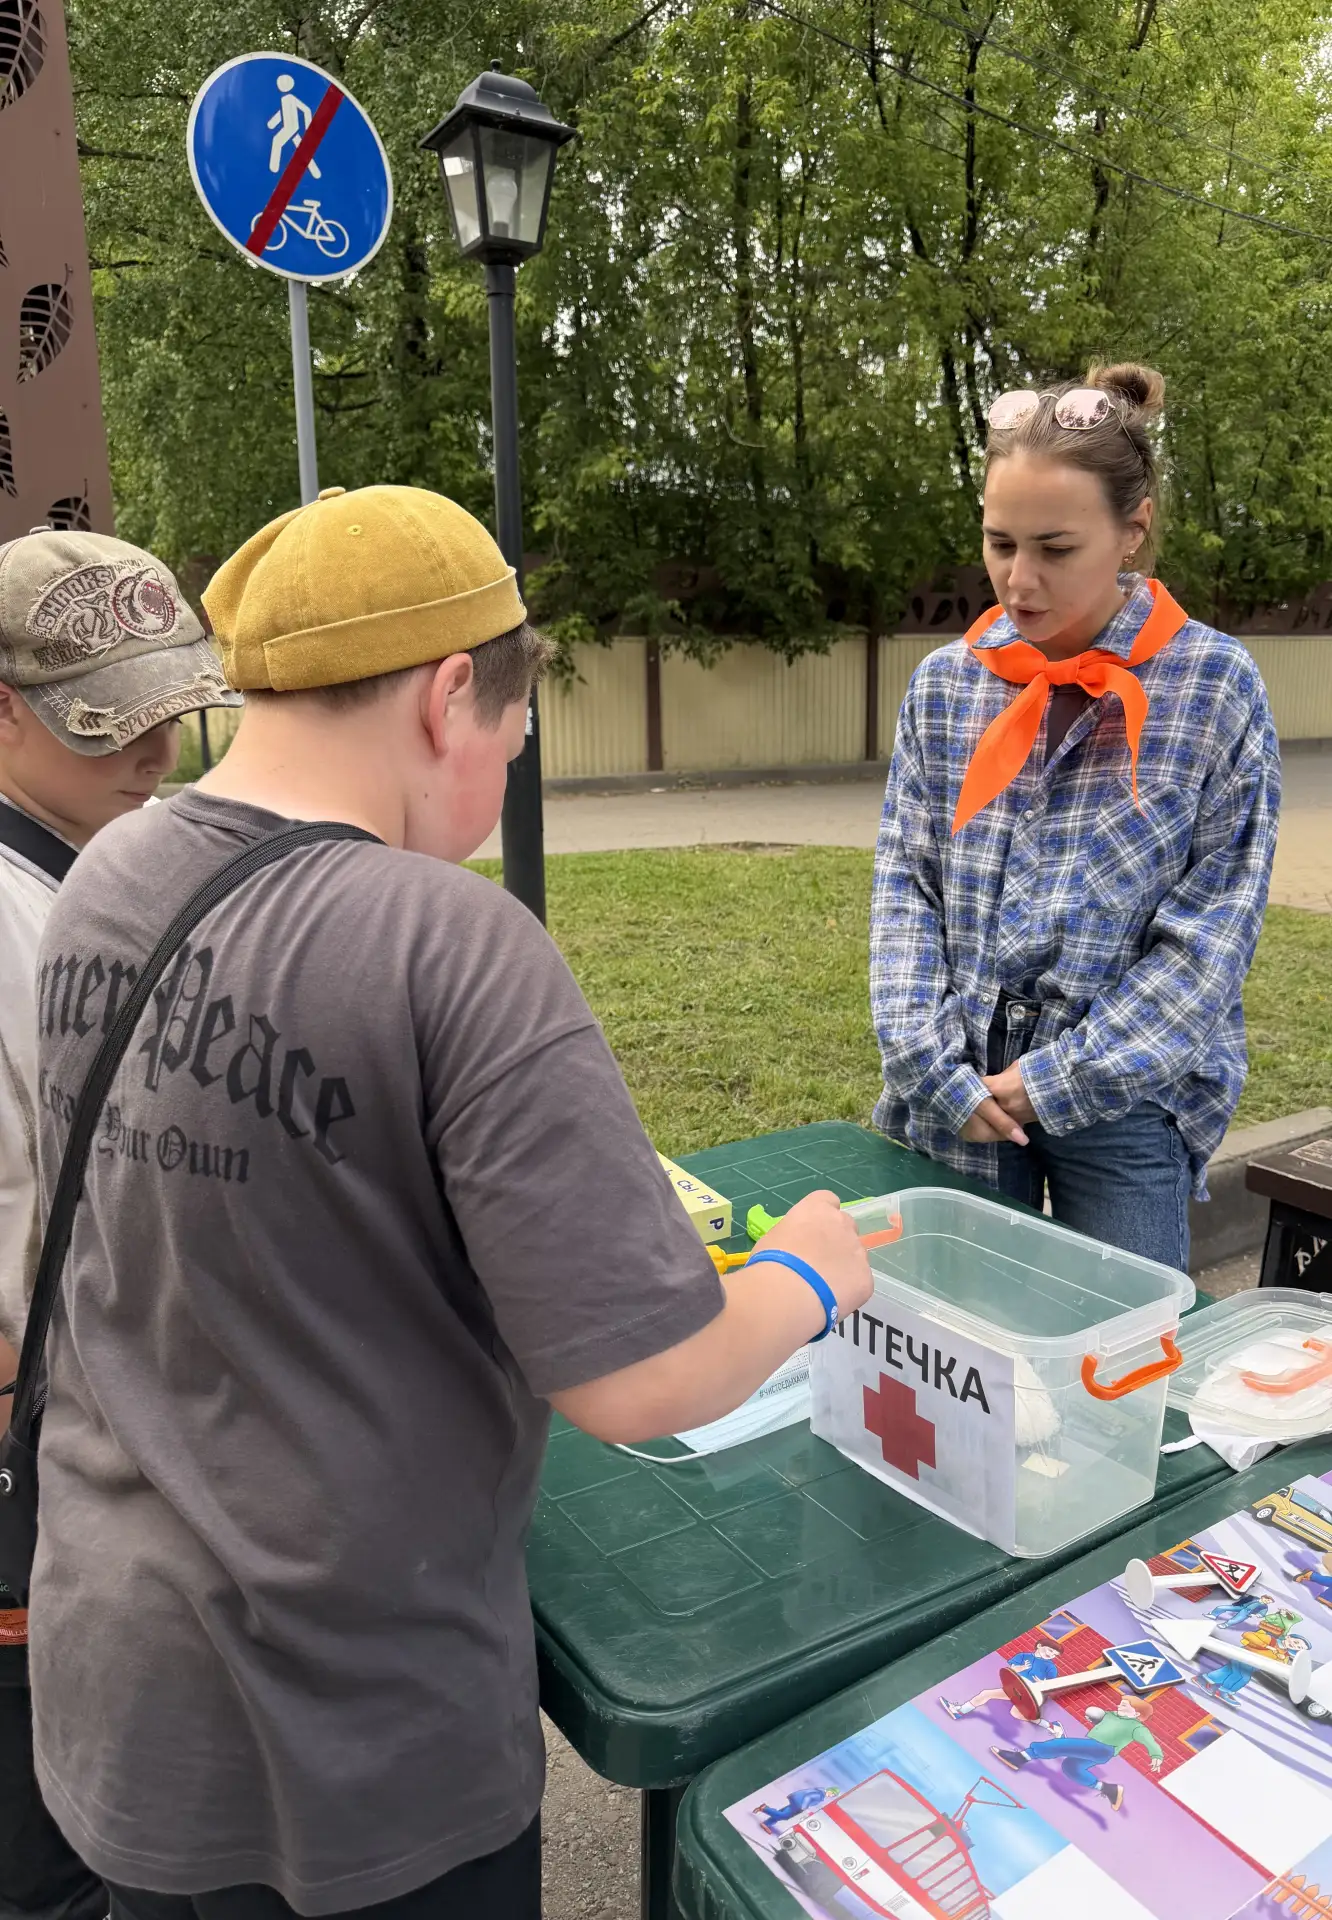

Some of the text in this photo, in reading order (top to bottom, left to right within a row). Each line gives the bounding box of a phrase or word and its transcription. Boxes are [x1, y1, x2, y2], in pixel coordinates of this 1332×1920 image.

[35, 568, 114, 631] SHARKS
[139, 943, 356, 1165] Peace
[157, 1124, 250, 1184] Own
[828, 1308, 991, 1415] ПТЕЧКА
